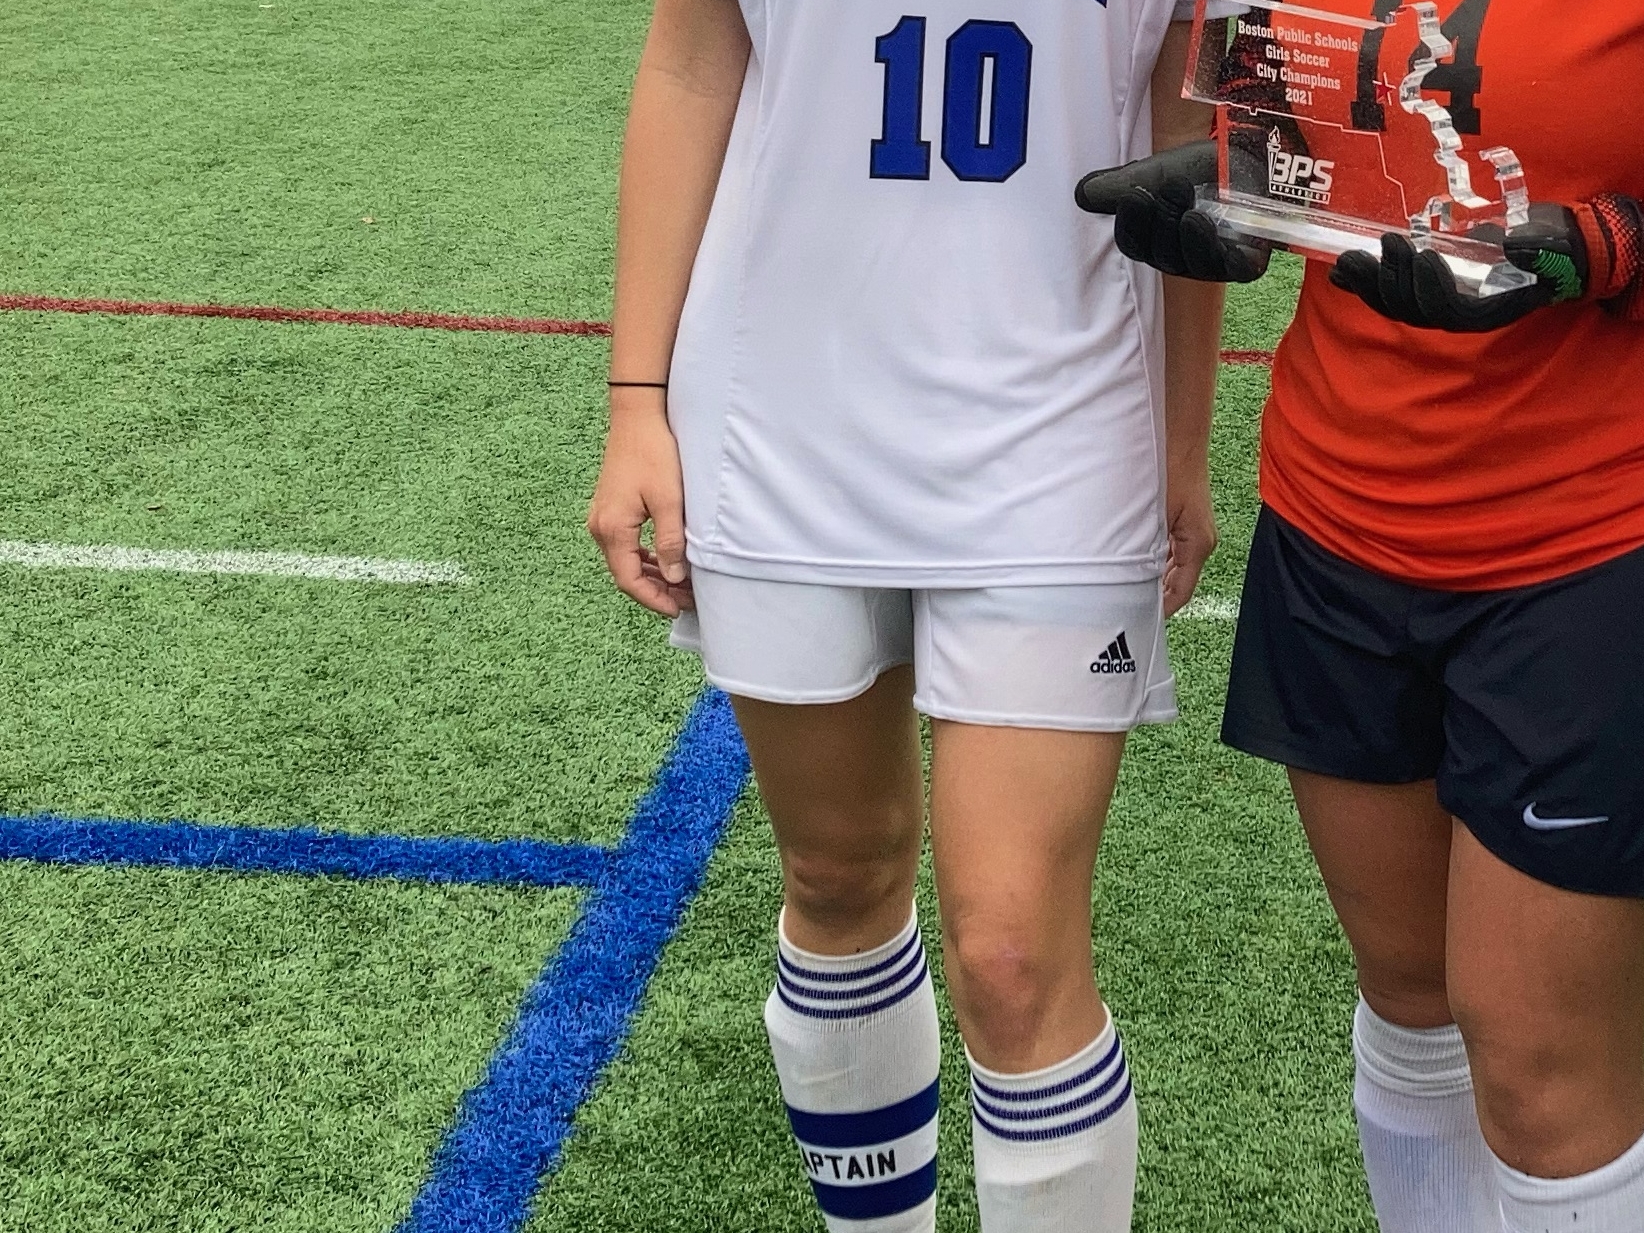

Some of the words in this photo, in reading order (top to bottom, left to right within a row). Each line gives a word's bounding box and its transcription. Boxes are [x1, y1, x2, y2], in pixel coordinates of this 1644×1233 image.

[1237, 20, 1274, 40] Boston
[1276, 25, 1312, 45] Public
[1314, 31, 1359, 53] Schools
[1265, 44, 1290, 62] Girls
[1293, 48, 1330, 69] Soccer
[1256, 63, 1278, 83] City
[1280, 66, 1341, 91] Champions
[869, 15, 1033, 183] 10
[1285, 87, 1313, 106] 2021
[1272, 151, 1335, 192] BPS
[1090, 659, 1136, 673] adidas
